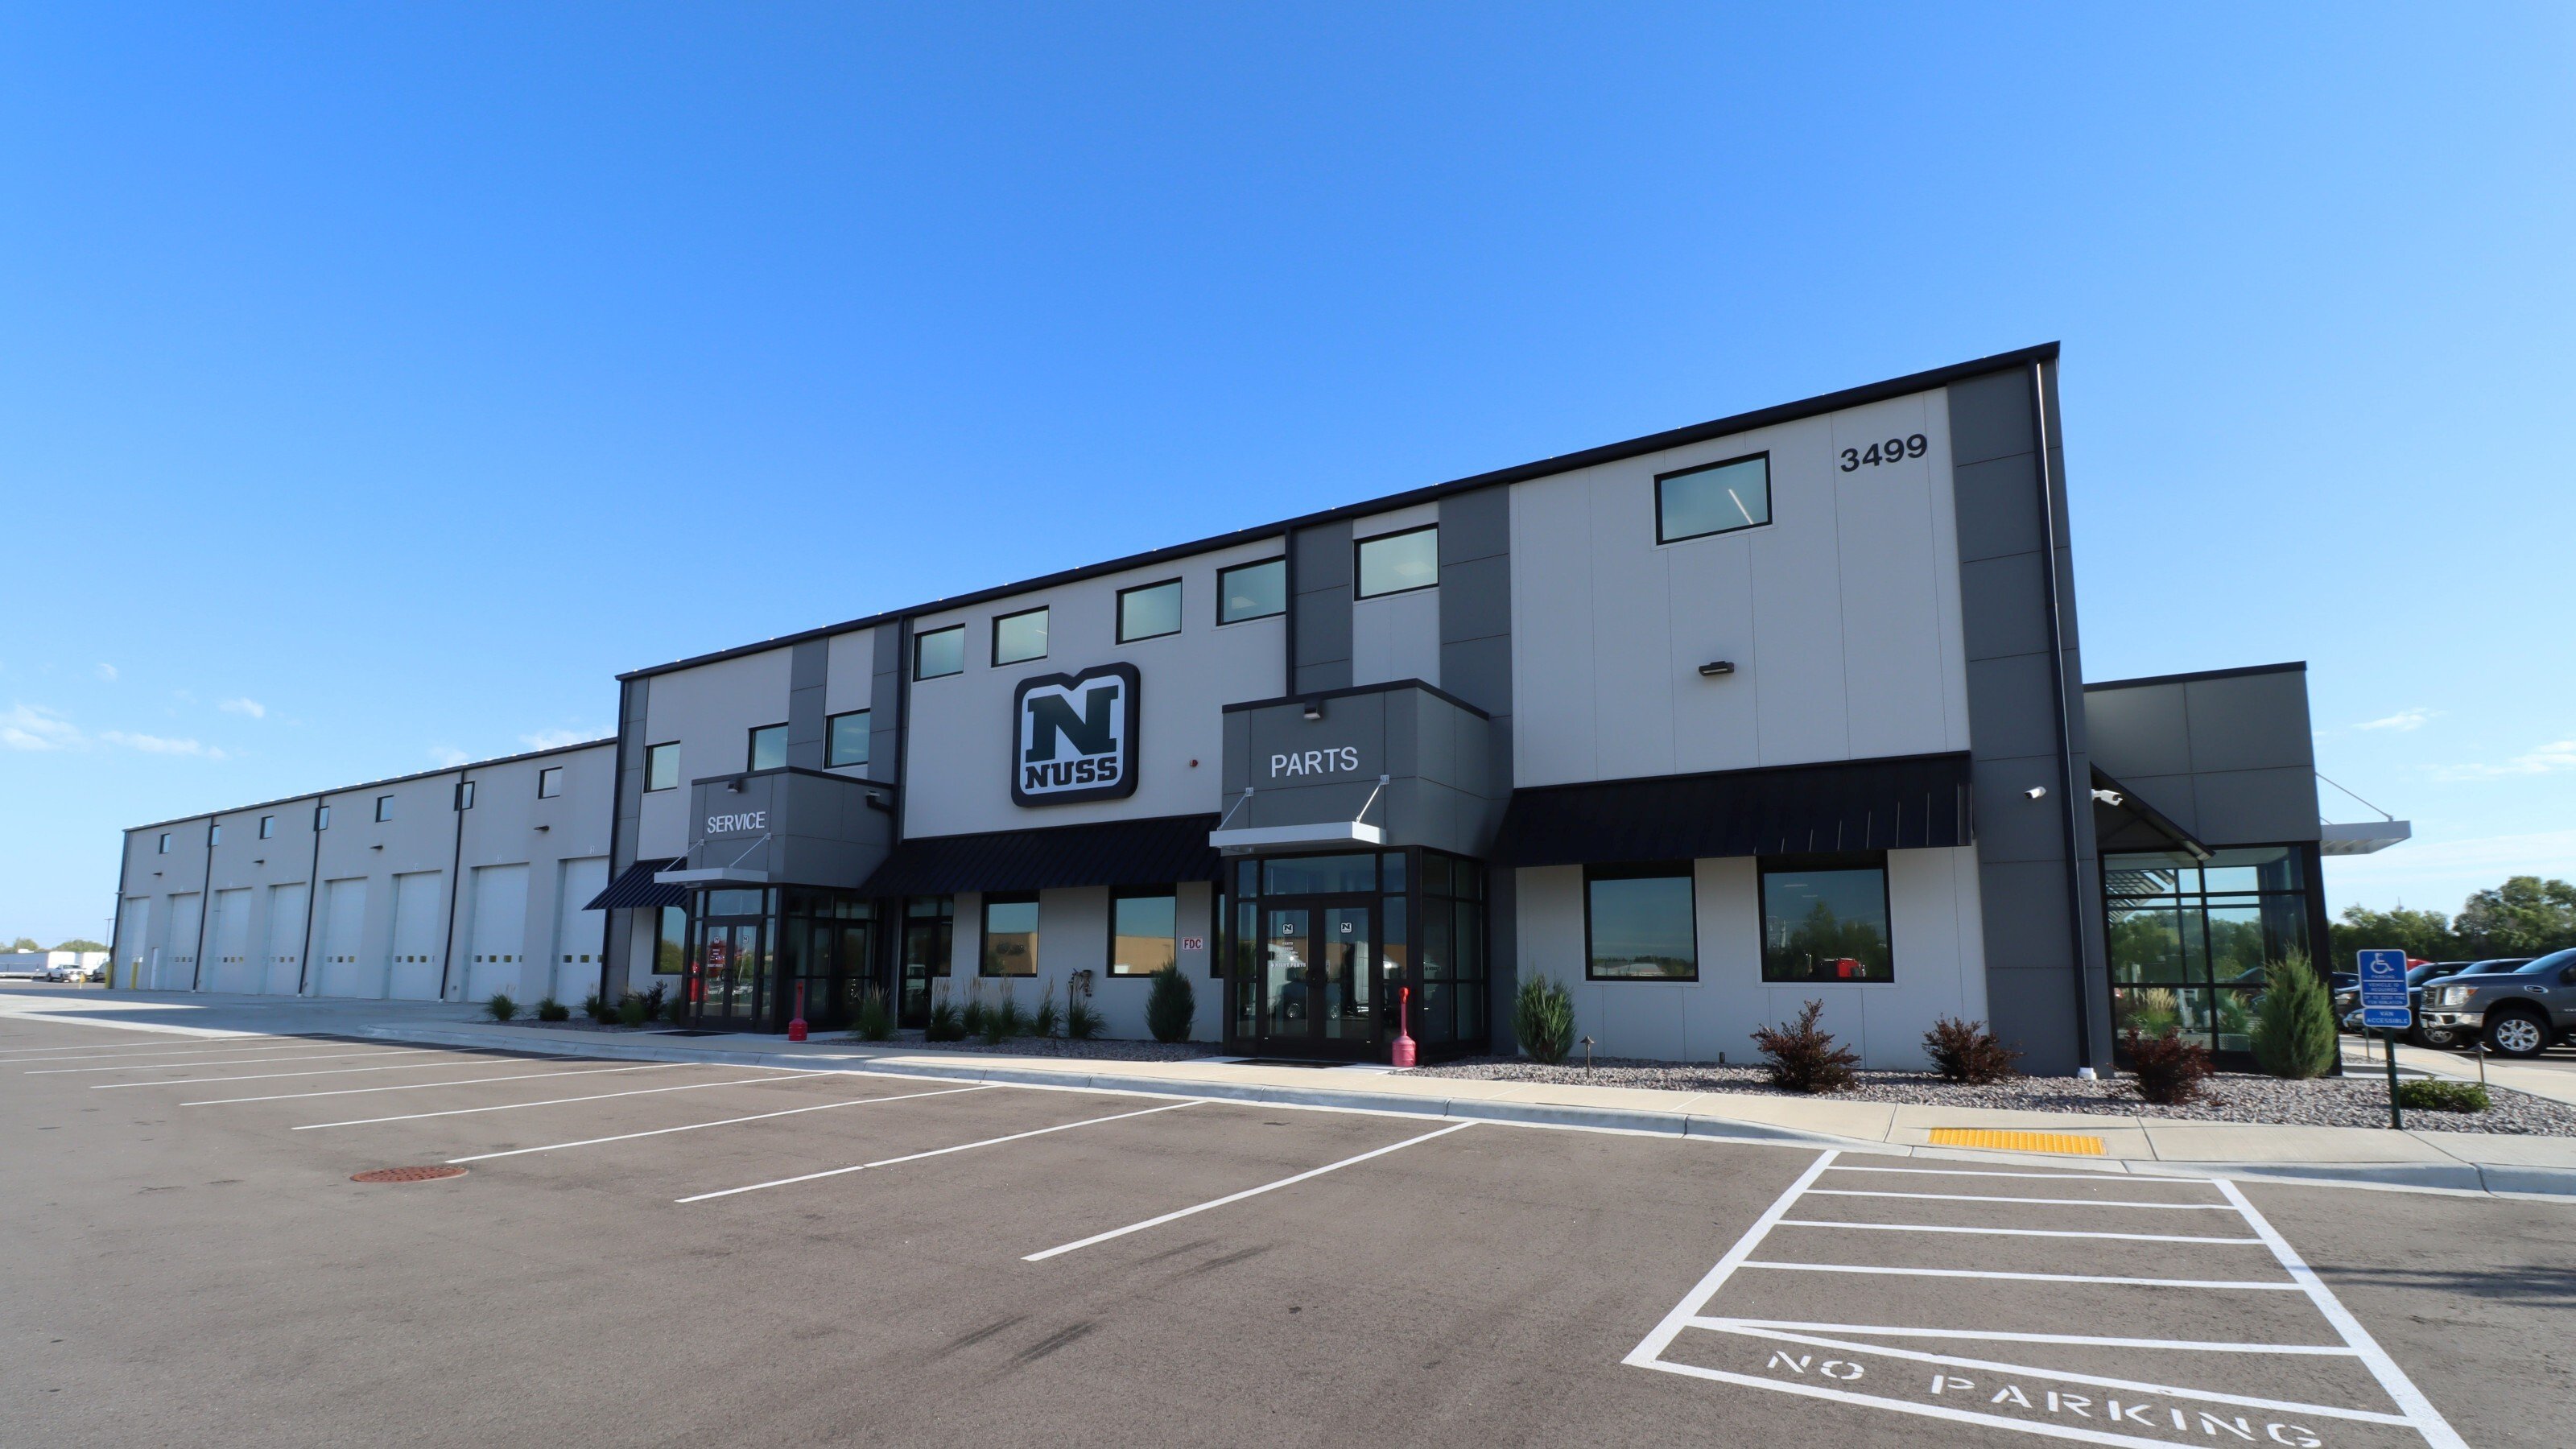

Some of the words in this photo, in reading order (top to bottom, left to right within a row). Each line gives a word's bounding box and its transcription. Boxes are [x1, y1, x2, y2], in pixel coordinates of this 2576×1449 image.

[1840, 433, 1928, 473] 3499
[1026, 685, 1119, 763] N
[1025, 756, 1118, 790] NUSS
[1271, 746, 1359, 778] PARTS
[707, 811, 766, 834] SERVICE
[1184, 939, 1201, 948] FDC
[1767, 1351, 1865, 1380] NO
[1930, 1375, 2322, 1448] PARKING
